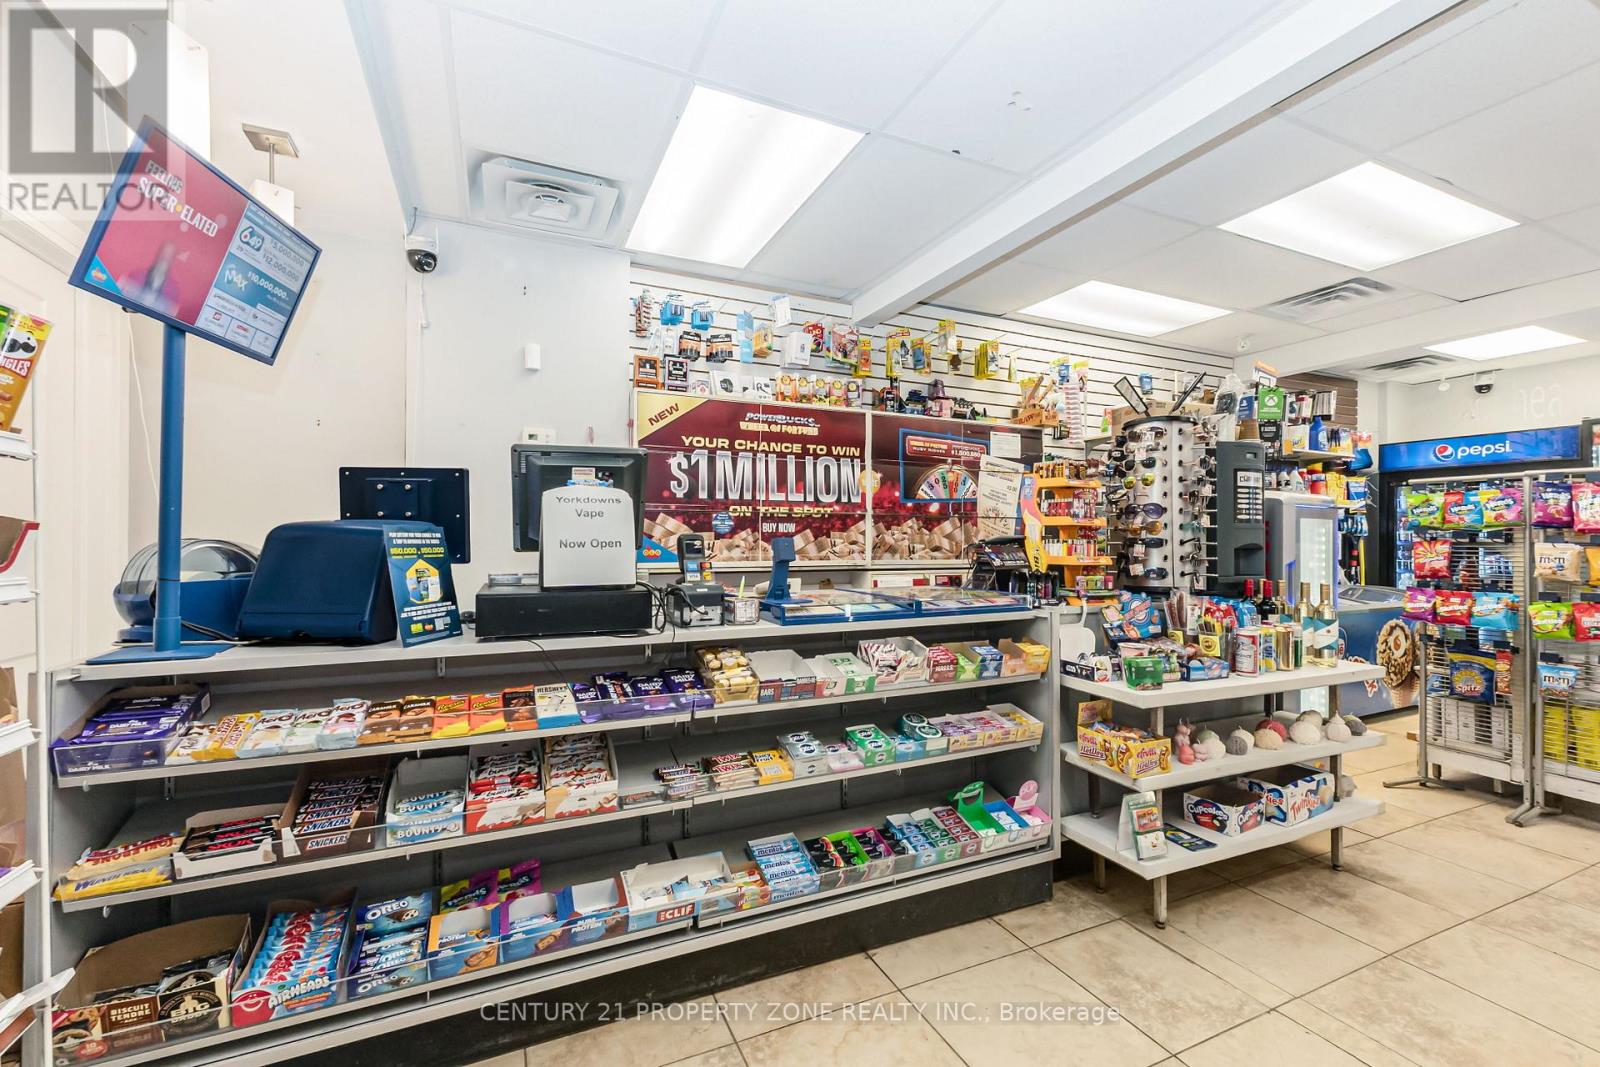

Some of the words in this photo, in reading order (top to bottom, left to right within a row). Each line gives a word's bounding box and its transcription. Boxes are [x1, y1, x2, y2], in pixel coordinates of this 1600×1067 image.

[648, 403, 680, 426] NEW
[681, 435, 728, 449] YOUR
[734, 439, 802, 454] CHANCE
[806, 445, 827, 455] TO
[832, 447, 861, 457] WIN
[1457, 440, 1513, 460] pepsi
[556, 496, 622, 505] Yorkdowns
[575, 508, 605, 520] Vape
[728, 505, 752, 517] ON
[757, 506, 791, 517] THE
[796, 506, 834, 518] SPOT
[762, 522, 777, 533] BUY
[778, 522, 796, 533] NOW
[559, 539, 586, 549] Now
[590, 539, 623, 551] Open
[1454, 683, 1481, 694] Spitz
[400, 801, 447, 813] BOUNTY
[303, 818, 352, 832] SNICKERS
[397, 824, 442, 839] BOUNTY
[307, 834, 349, 849] SNICKERS
[757, 845, 784, 856] mentos
[764, 860, 791, 870] mentos
[769, 869, 797, 880] mentos
[365, 900, 409, 920] OREO
[357, 974, 398, 993] OREO
[267, 976, 331, 1010] AIRHEADS
[110, 1003, 151, 1015] BISCUIT
[110, 1009, 152, 1022] TENDRE
[170, 1002, 211, 1018] BIG
